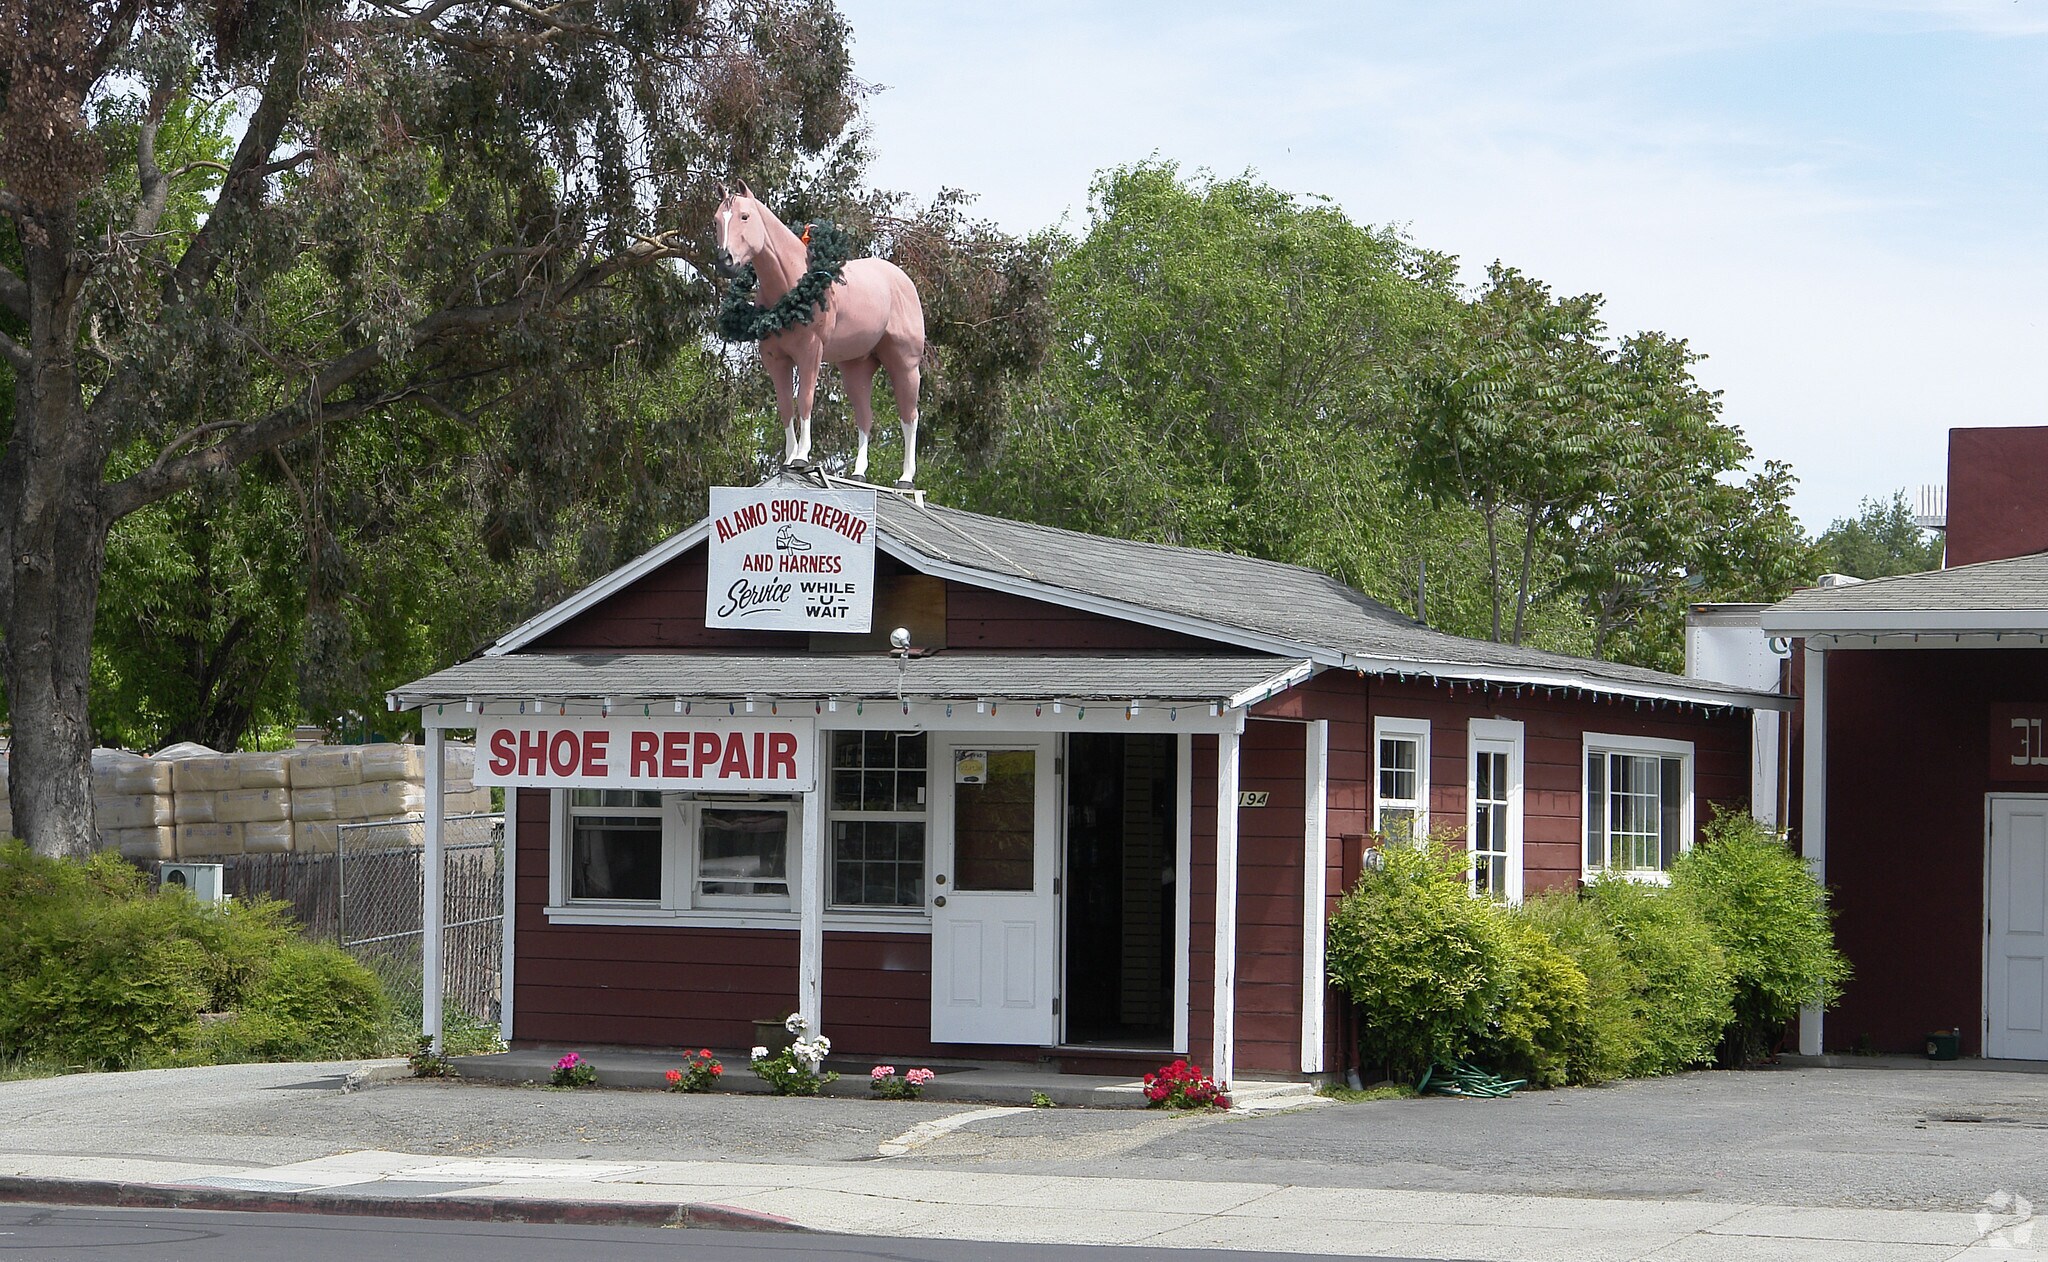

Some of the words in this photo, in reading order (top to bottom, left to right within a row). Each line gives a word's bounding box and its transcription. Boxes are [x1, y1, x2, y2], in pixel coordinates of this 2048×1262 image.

[715, 502, 768, 544] ALAMO
[771, 499, 809, 523] SHOE
[811, 502, 867, 544] REPAIR
[742, 554, 773, 572] AND
[779, 555, 842, 573] HARNESS
[717, 576, 792, 618] Service
[800, 582, 856, 594] WHILE
[805, 606, 850, 618] WAIT
[488, 729, 610, 778] SHOE
[630, 731, 798, 779] REPAIR
